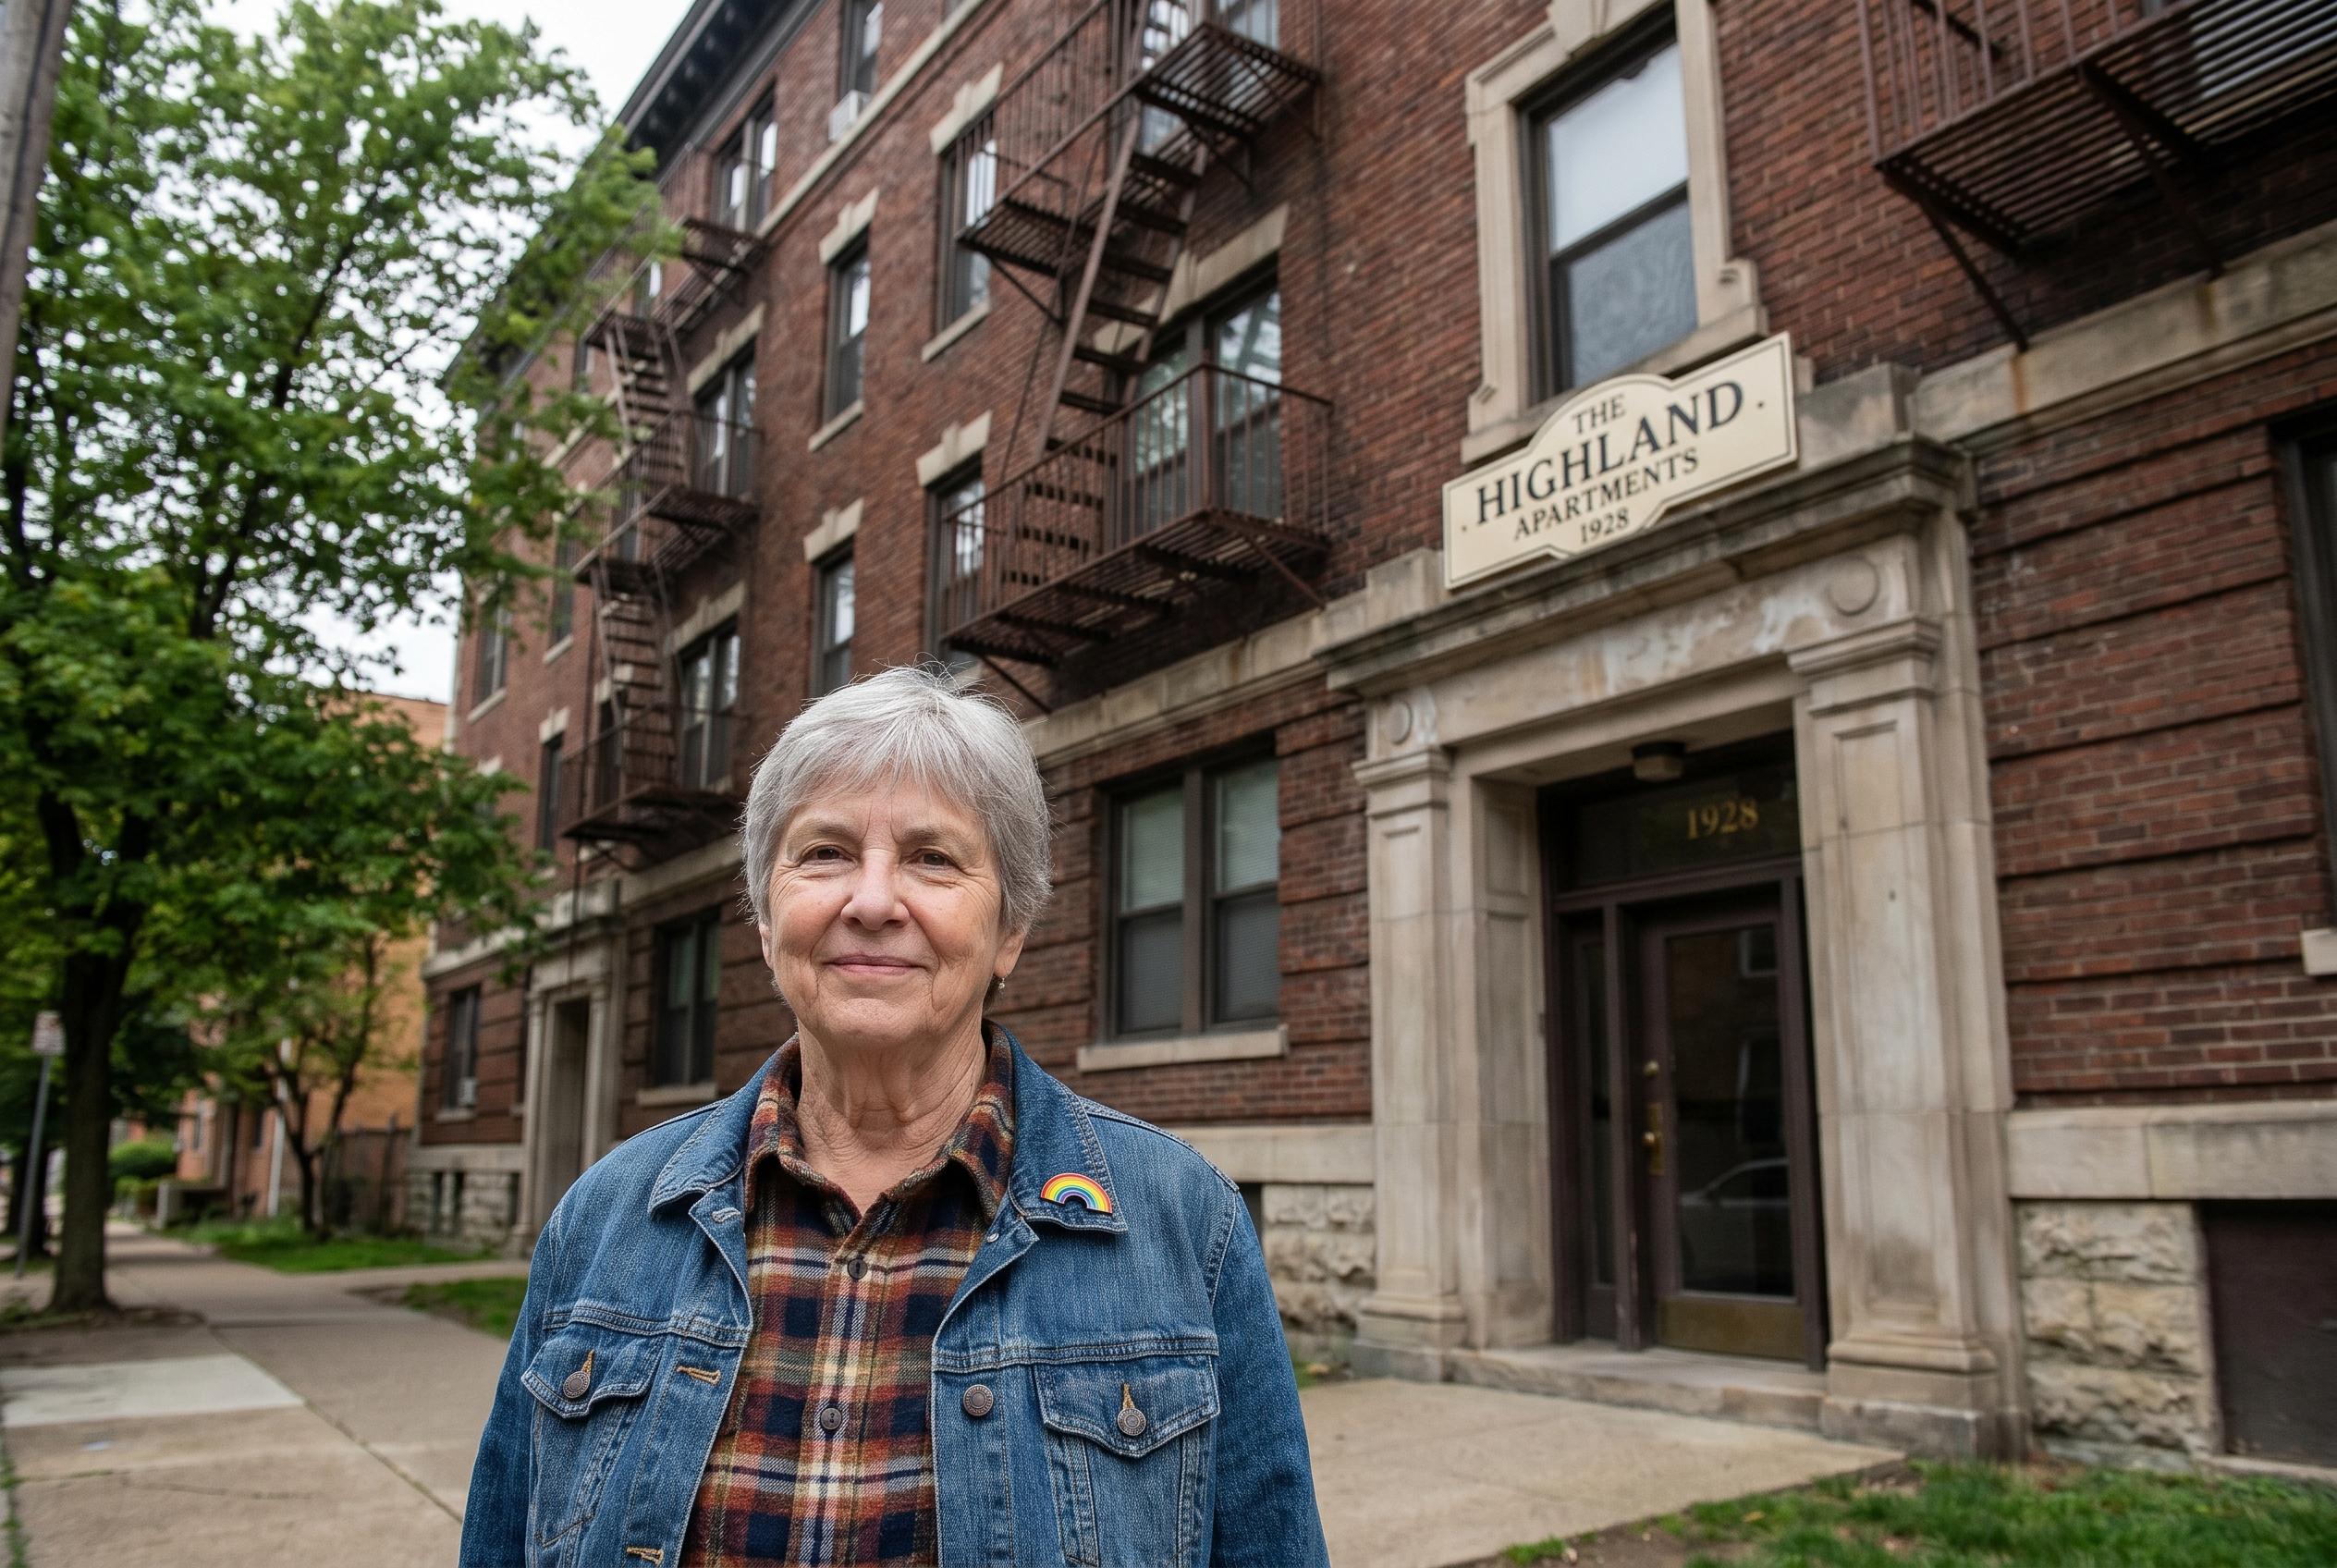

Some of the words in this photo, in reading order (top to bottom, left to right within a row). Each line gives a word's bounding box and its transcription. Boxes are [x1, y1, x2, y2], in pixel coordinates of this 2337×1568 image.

[1572, 394, 1626, 435] THE
[1476, 380, 1744, 526] HIGHLAND
[1514, 447, 1699, 542] APARTMENTS
[1581, 508, 1631, 545] 1928
[1687, 798, 1758, 840] 1928
